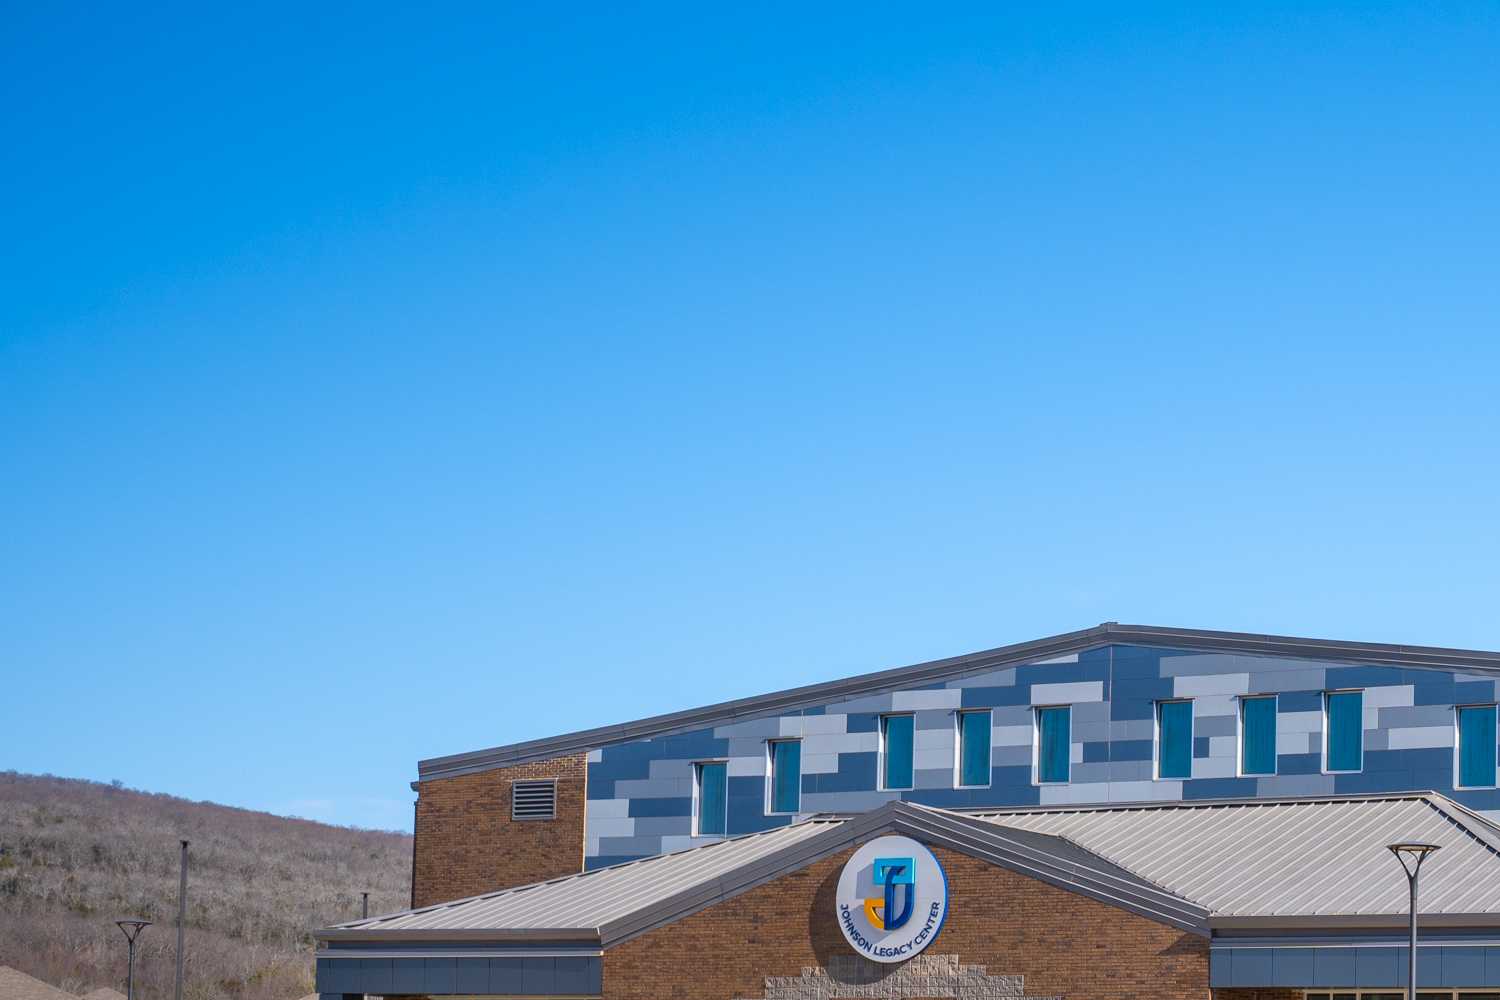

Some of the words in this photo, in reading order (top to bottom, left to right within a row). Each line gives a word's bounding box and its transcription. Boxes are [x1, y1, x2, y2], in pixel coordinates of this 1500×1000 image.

[840, 903, 873, 953] JOHNSON
[873, 940, 913, 957] LEGACY
[914, 901, 940, 946] CENTER
